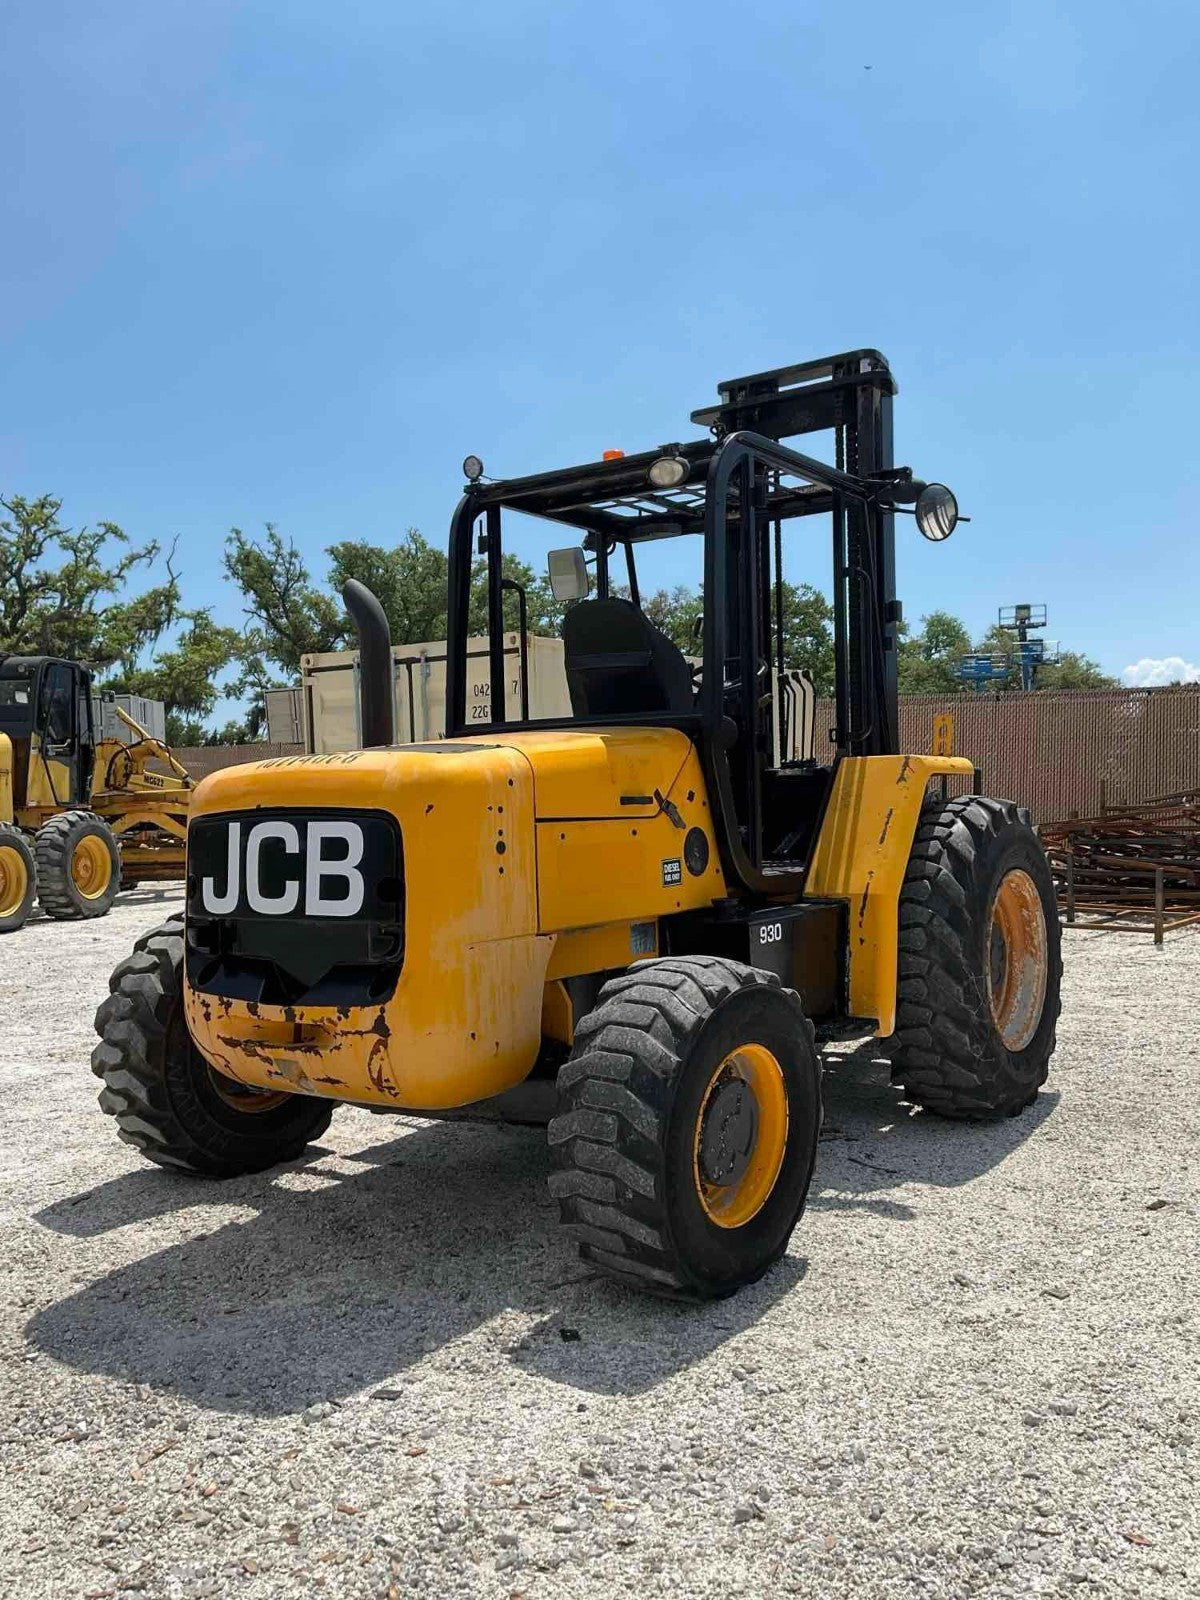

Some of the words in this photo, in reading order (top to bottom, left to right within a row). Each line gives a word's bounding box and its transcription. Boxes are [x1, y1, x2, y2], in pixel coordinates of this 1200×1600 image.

[472, 704, 492, 719] 22G
[202, 821, 365, 917] JCB
[664, 862, 680, 873] DIESEL
[760, 923, 782, 944] 930
